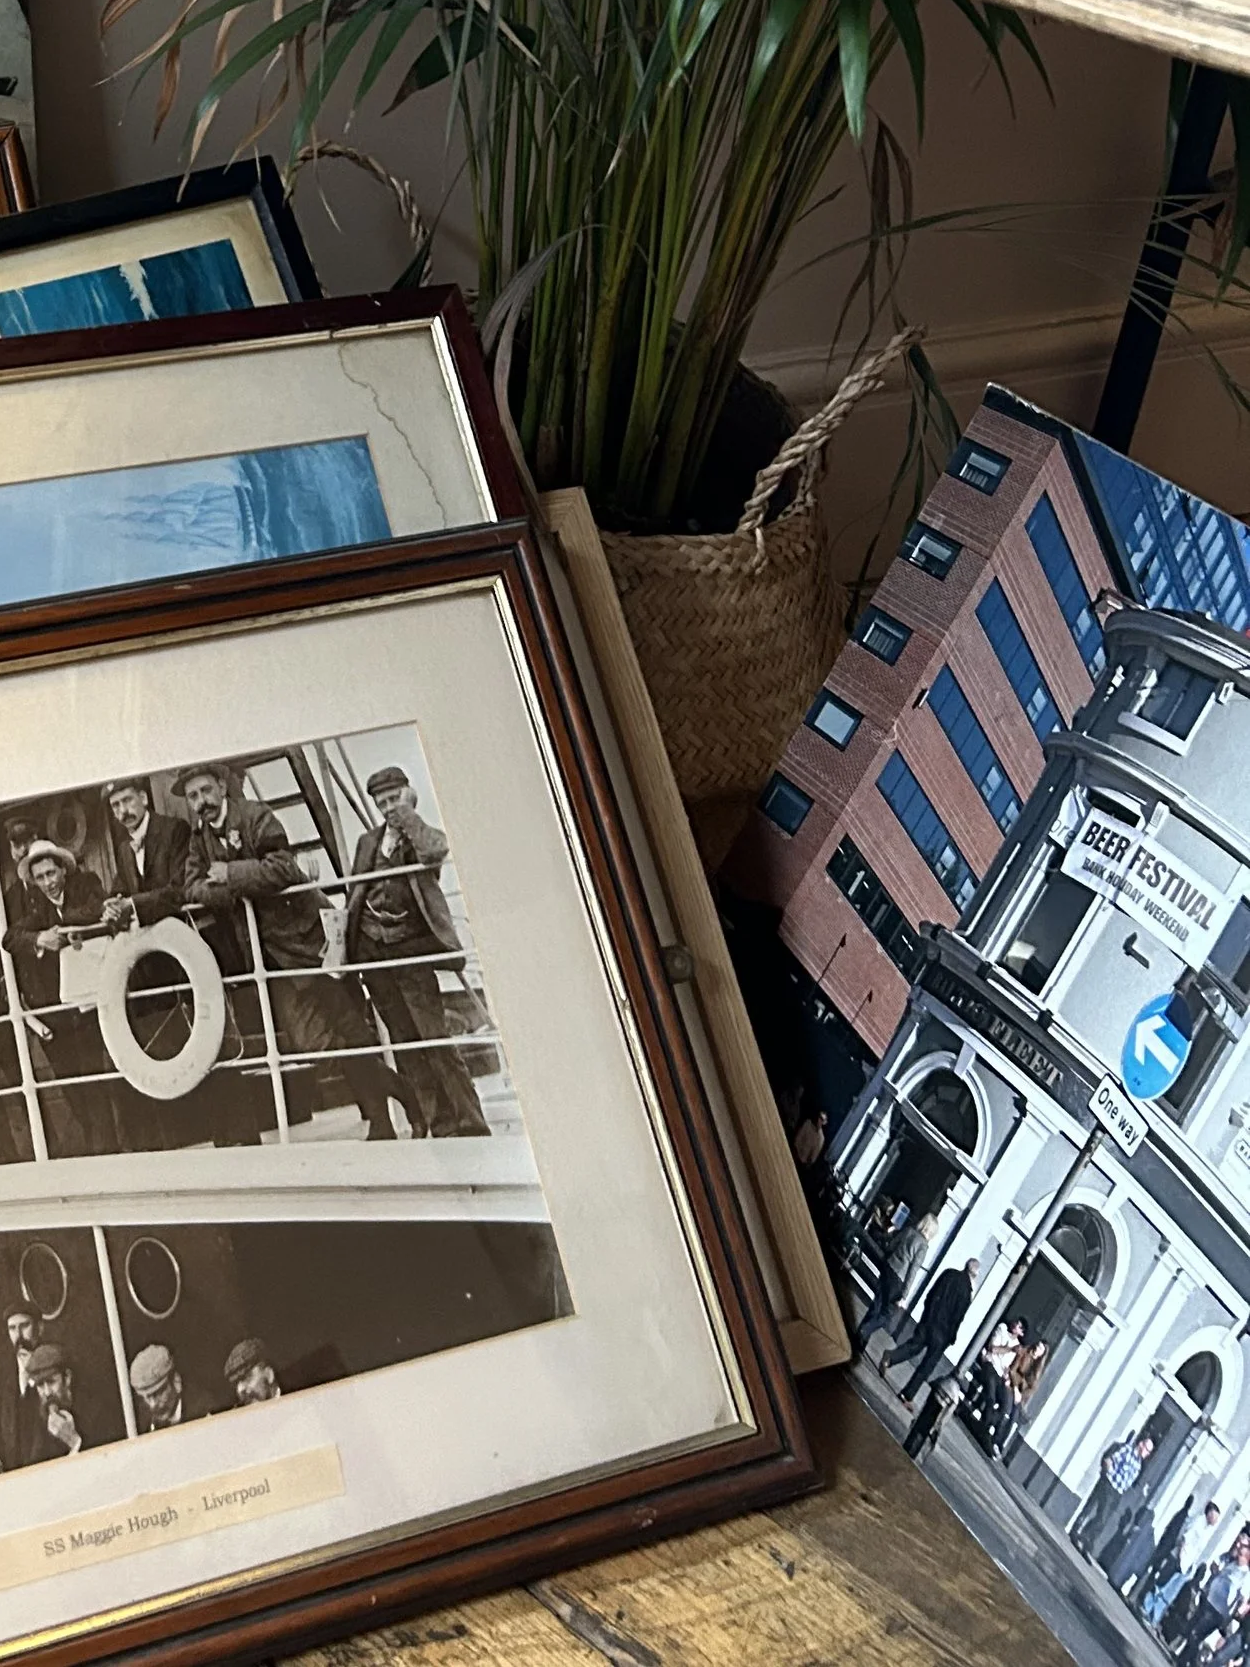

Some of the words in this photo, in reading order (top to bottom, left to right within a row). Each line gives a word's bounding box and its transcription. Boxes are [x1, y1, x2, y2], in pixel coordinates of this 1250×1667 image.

[1081, 820, 1131, 863] BEER
[1128, 844, 1218, 932] FESTIVAL
[1082, 856, 1107, 881] BANK
[1143, 897, 1191, 943] WEEKEND
[1097, 1087, 1120, 1120] One
[1117, 1114, 1140, 1146] way
[43, 1538, 67, 1559] SS
[69, 1523, 124, 1550] Maggie
[127, 1505, 180, 1534] Hough
[201, 1478, 271, 1512] Liverpool
